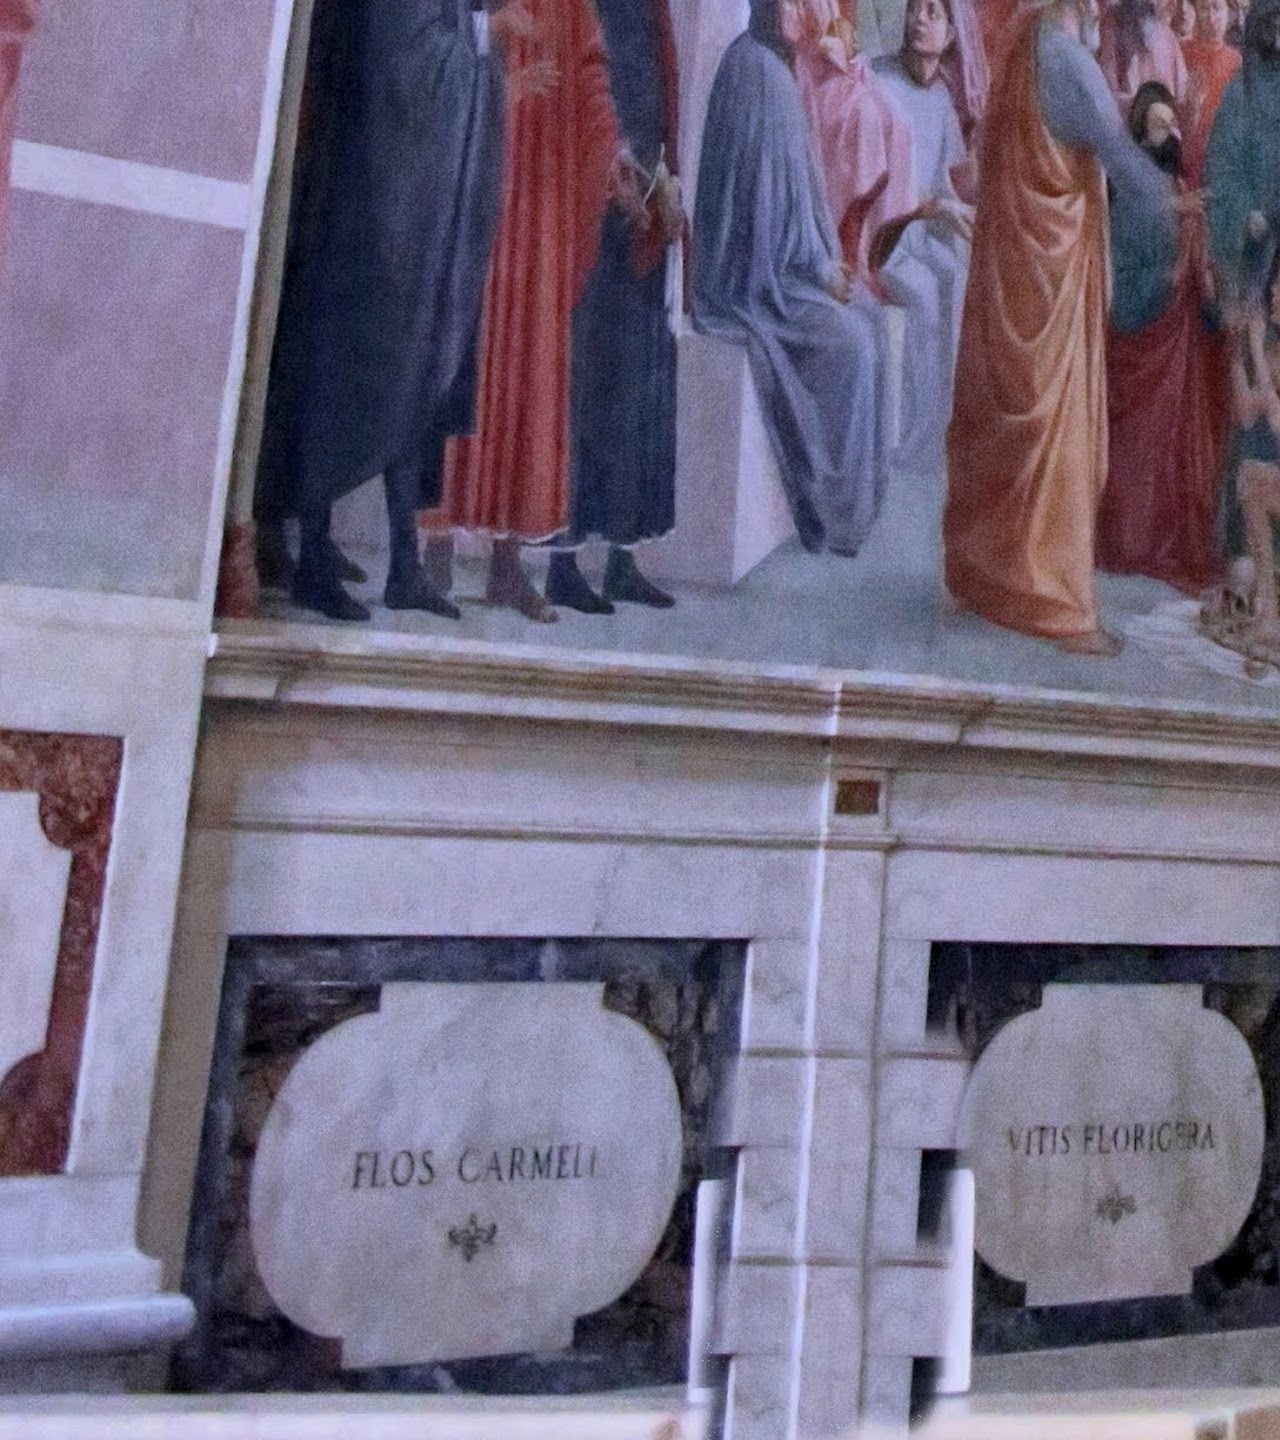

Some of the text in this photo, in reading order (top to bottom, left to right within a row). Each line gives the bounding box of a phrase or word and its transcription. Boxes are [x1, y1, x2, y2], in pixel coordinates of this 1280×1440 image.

[1008, 1124, 1070, 1156] VITIS
[352, 1142, 597, 1191] FLOS CARMELI
